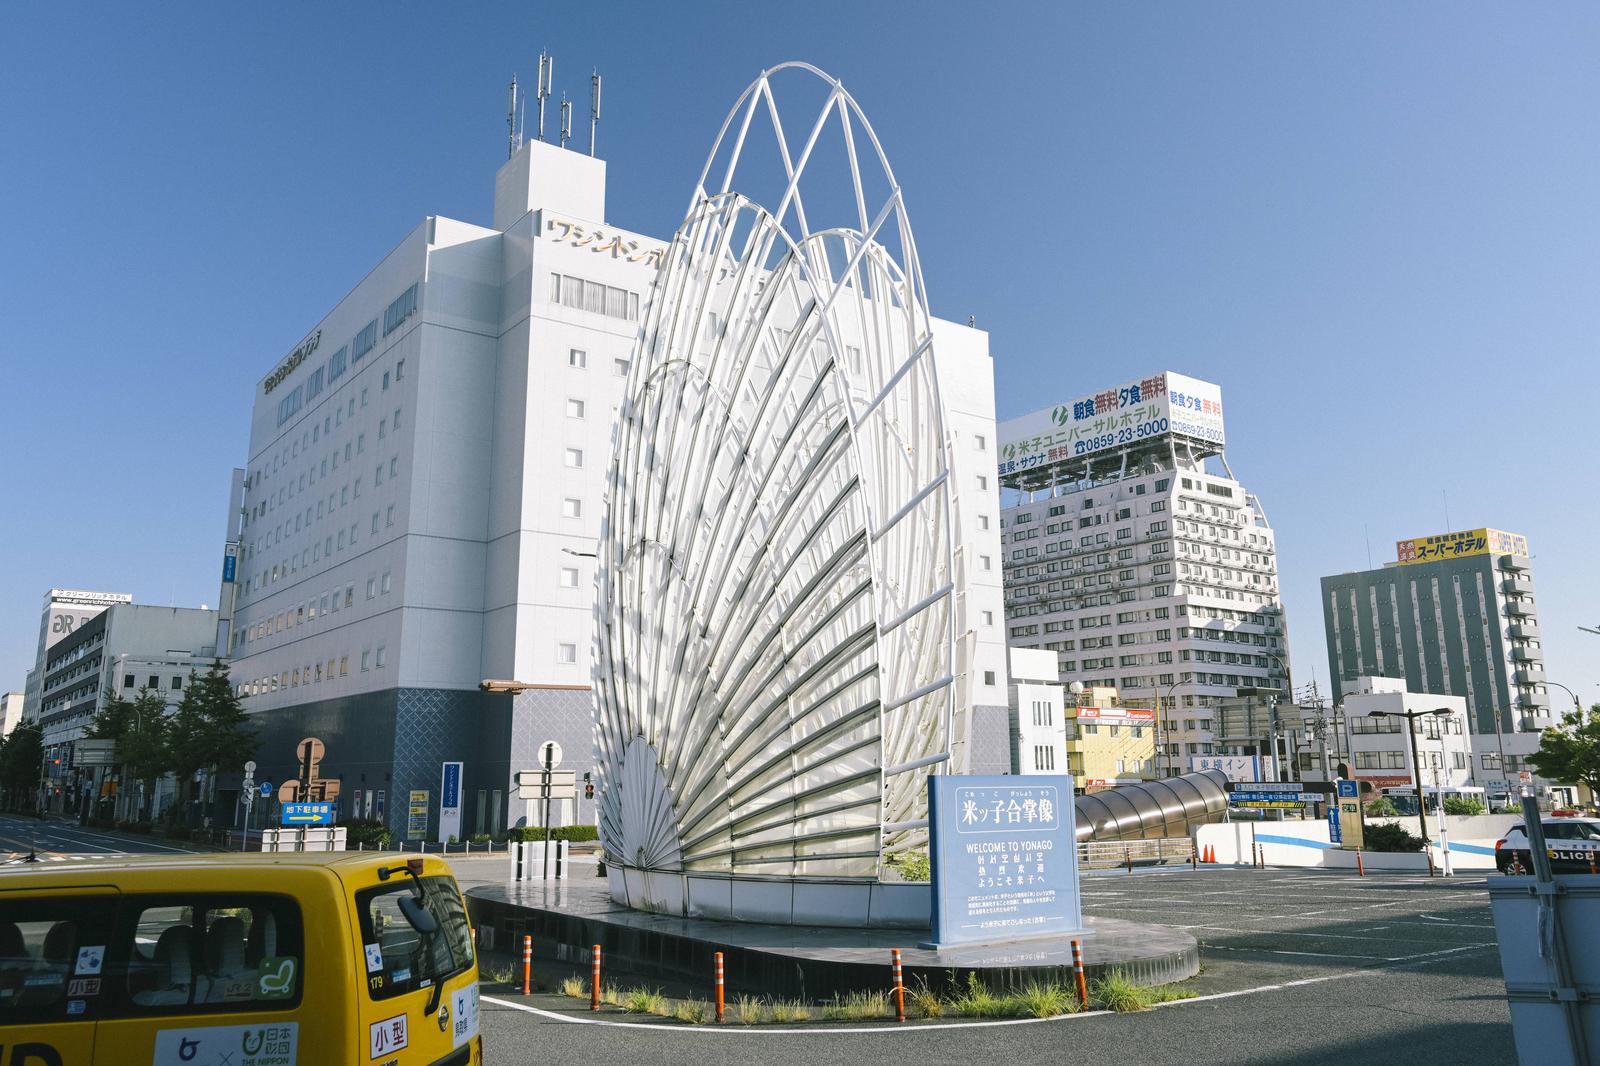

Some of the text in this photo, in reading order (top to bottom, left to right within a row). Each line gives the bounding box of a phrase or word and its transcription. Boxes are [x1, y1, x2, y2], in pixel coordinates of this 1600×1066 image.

[1018, 404, 1160, 455] 米子ユニバーサルホテル
[1086, 417, 1168, 451] 0859-23-5000
[1417, 537, 1486, 558] スーパーホテル
[1201, 759, 1246, 770] 東横イン
[962, 799, 1053, 825] 米ッ子合掌像
[966, 840, 1053, 854] WELCOME TO YONAGO
[1547, 851, 1595, 861] OLICE
[370, 976, 384, 990] 179
[266, 1027, 291, 1041] 日本
[375, 1019, 405, 1052] 小型
[241, 1057, 289, 1066] THE NIPPON
